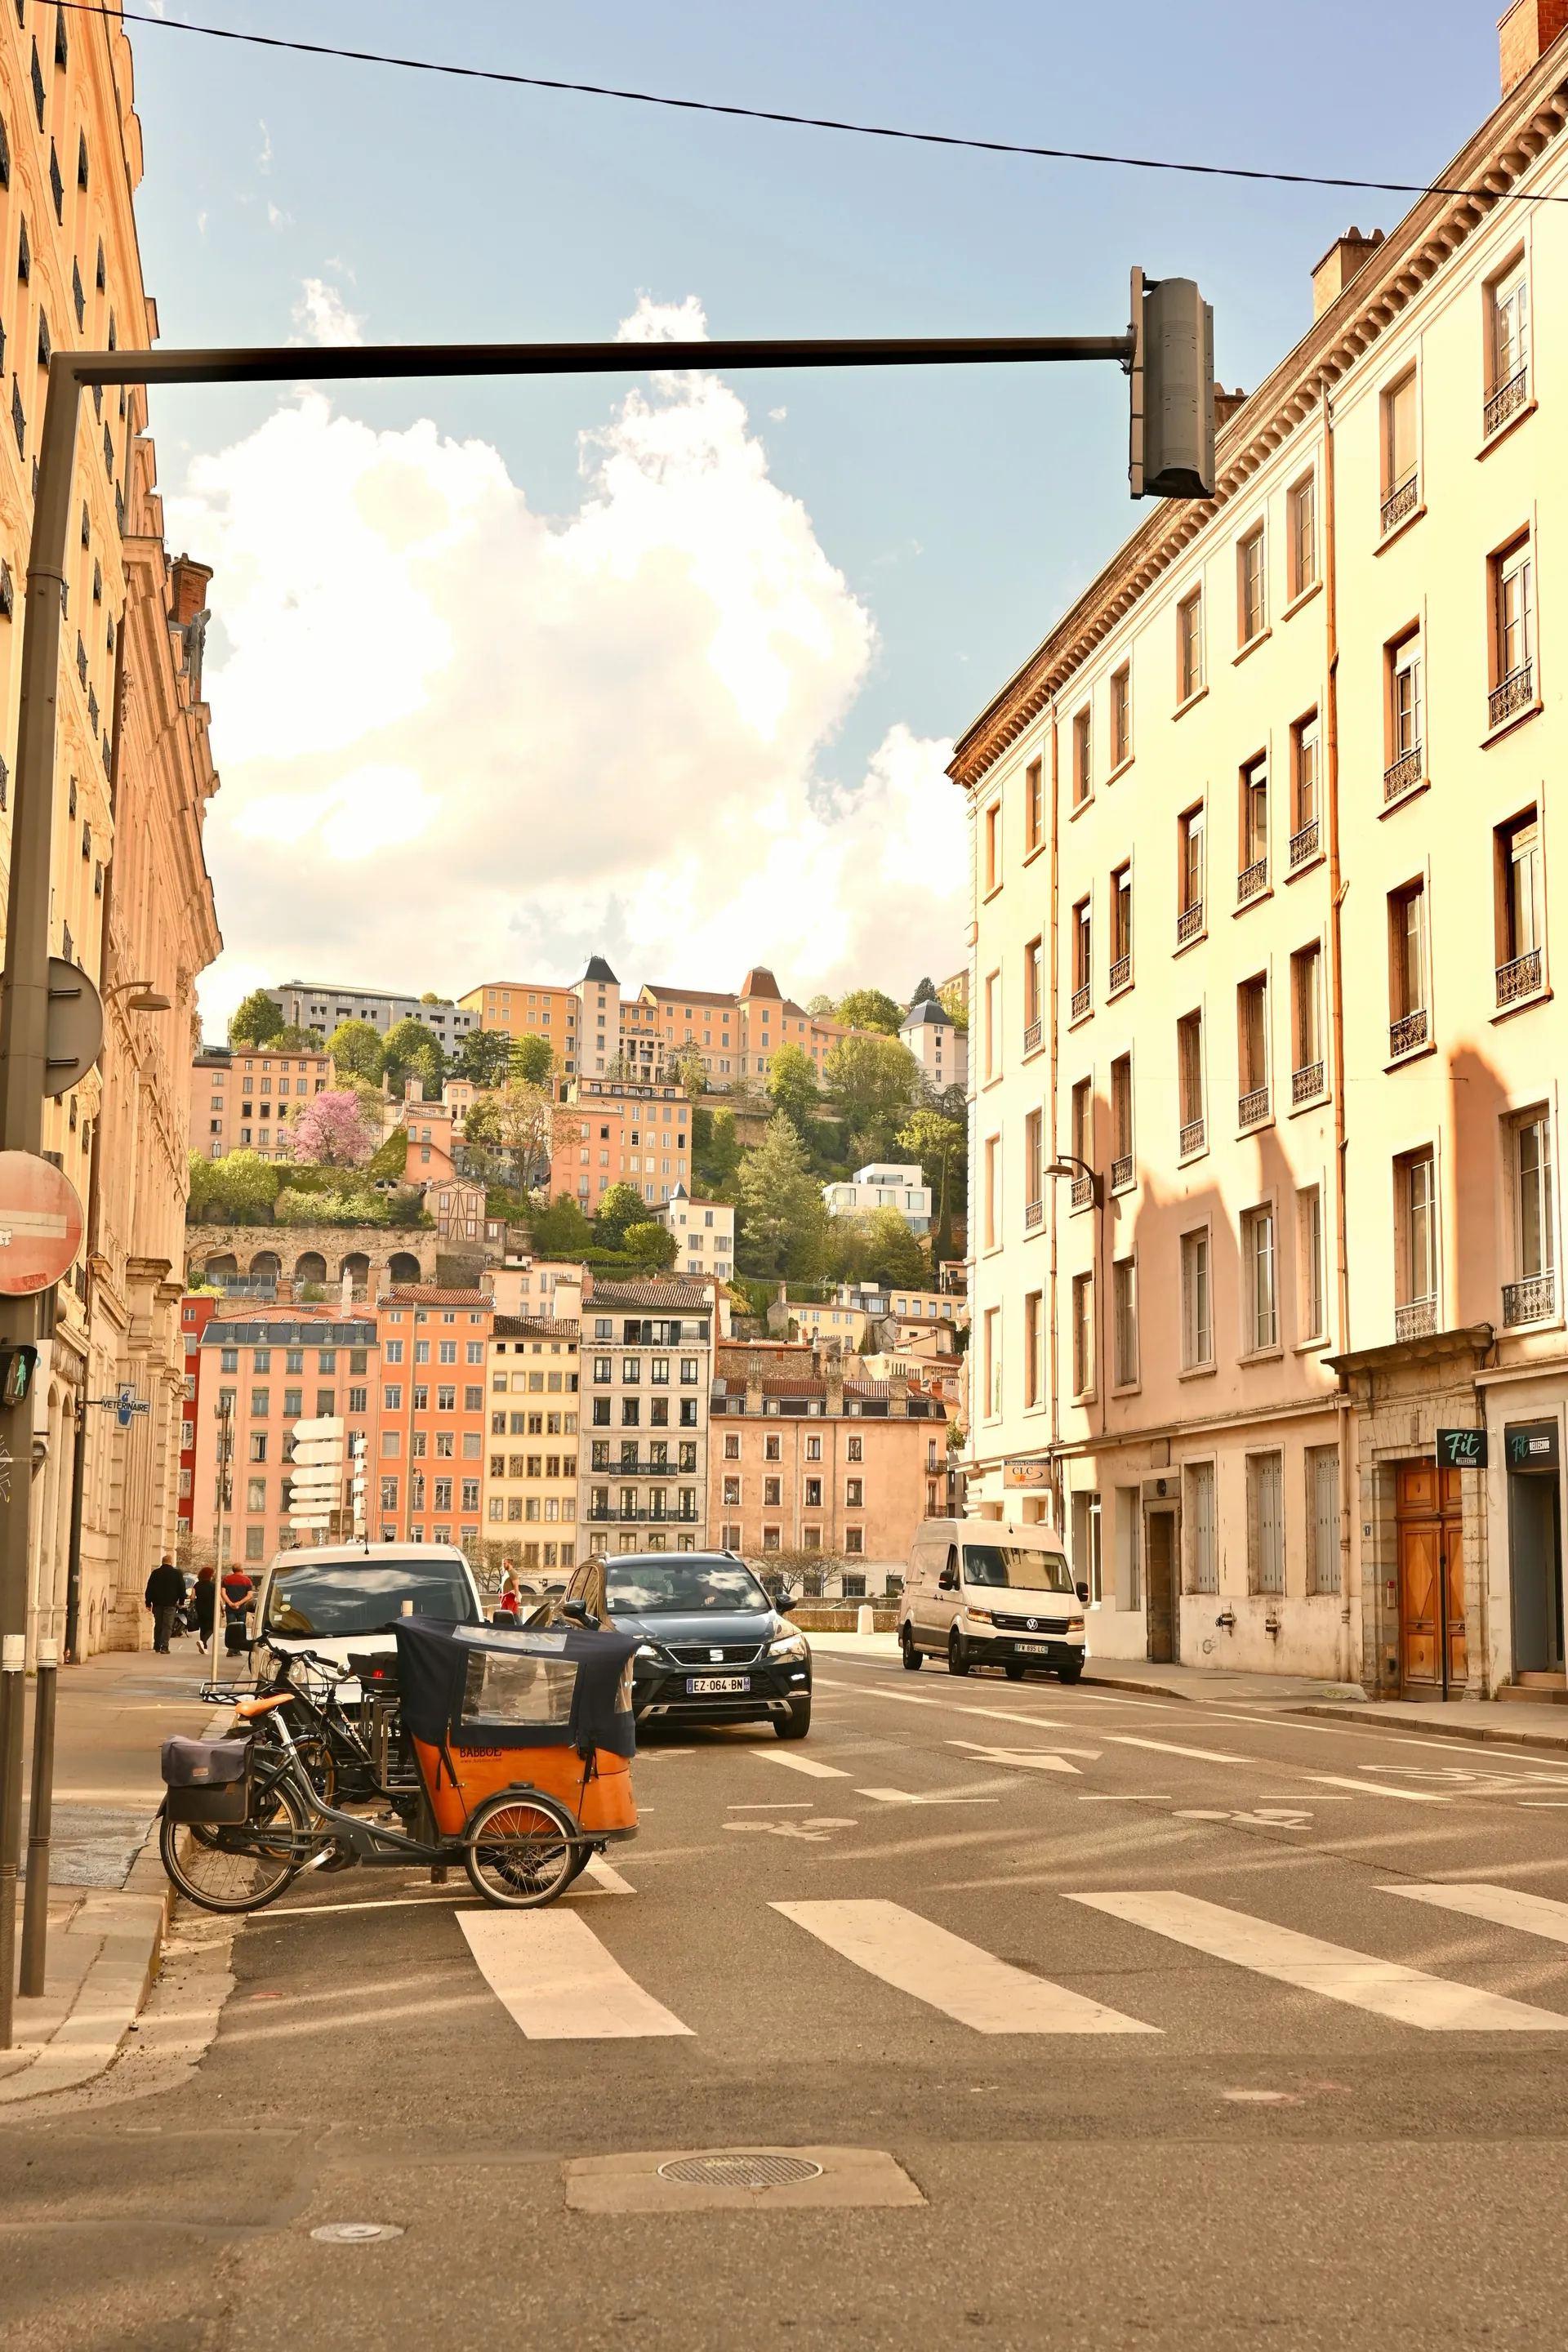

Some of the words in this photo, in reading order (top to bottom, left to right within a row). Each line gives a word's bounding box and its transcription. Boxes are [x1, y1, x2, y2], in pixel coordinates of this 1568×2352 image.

[1445, 1432, 1481, 1460] Fit
[1512, 1436, 1529, 1463] Fit
[1530, 1440, 1550, 1451] BELLECOUR
[1012, 1467, 1033, 1475] CLC
[460, 1747, 502, 1758] BABBOE
